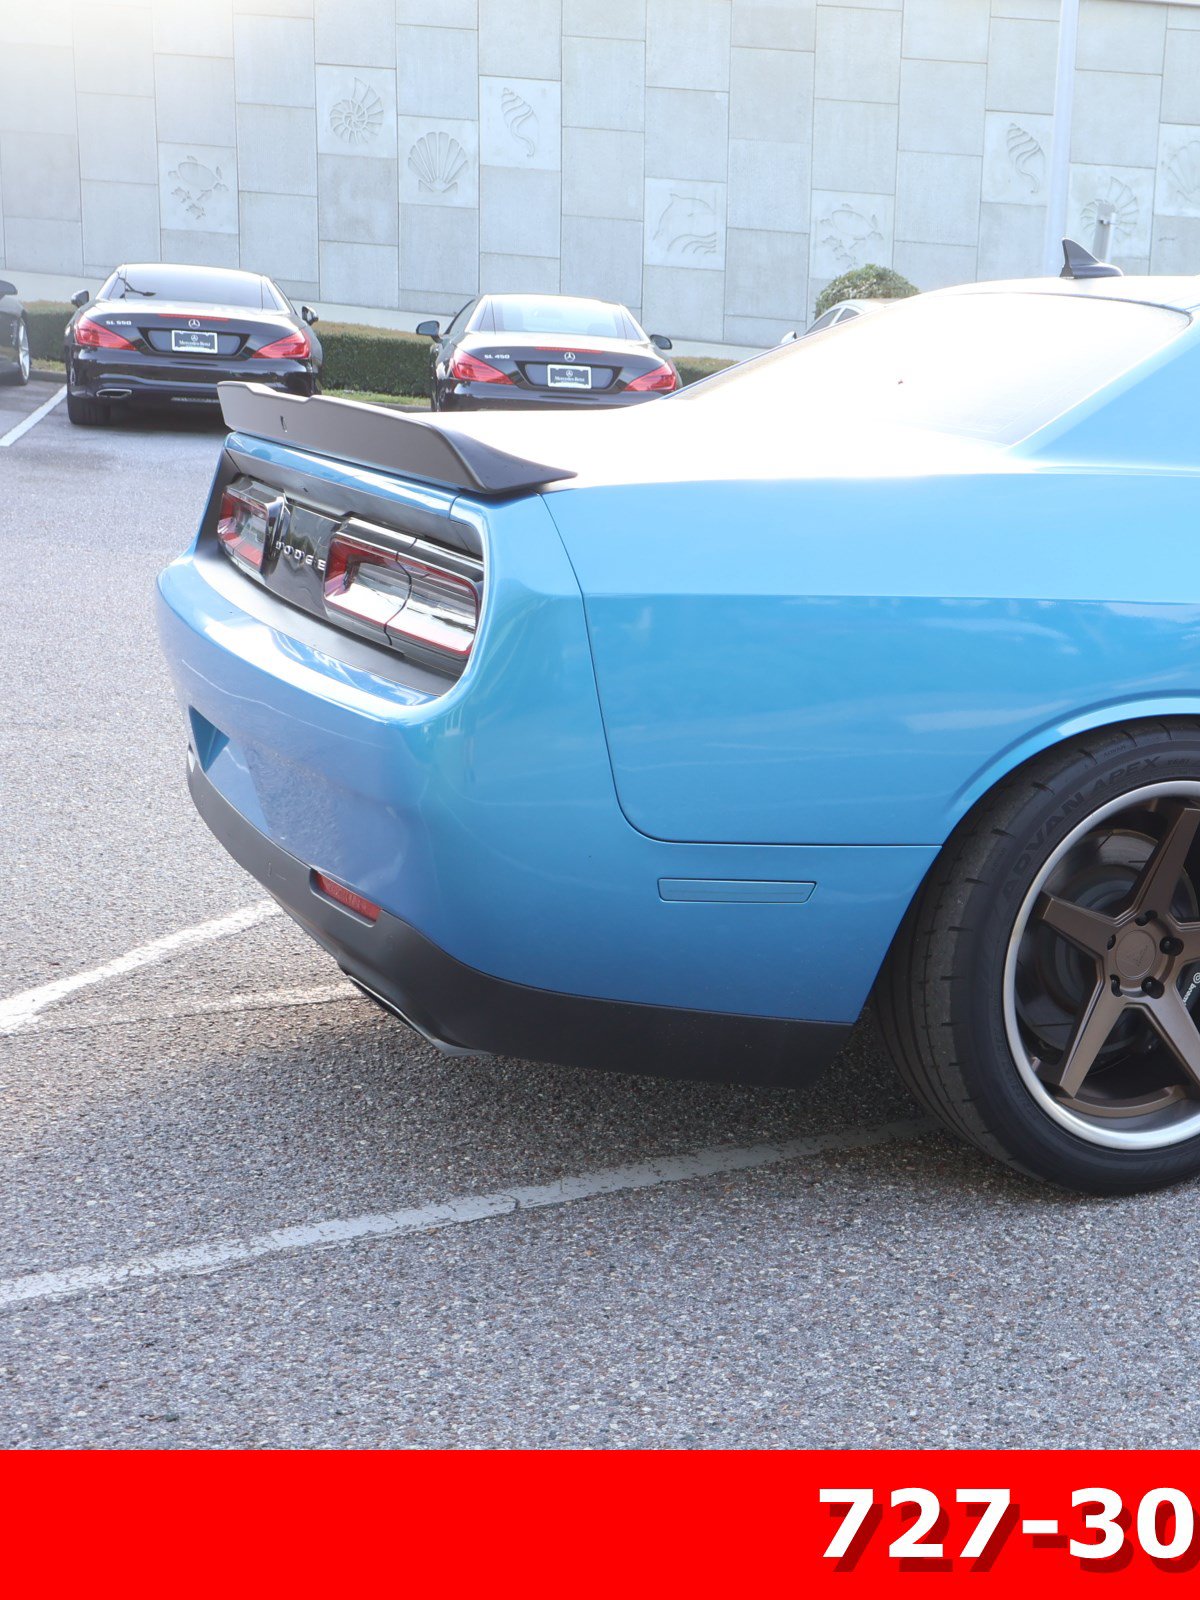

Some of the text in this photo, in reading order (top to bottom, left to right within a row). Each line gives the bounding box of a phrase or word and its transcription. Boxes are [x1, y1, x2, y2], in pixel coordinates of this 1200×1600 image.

[275, 540, 327, 571] DODGE
[1001, 790, 1086, 899] ADVAN
[1092, 755, 1161, 794] APEX
